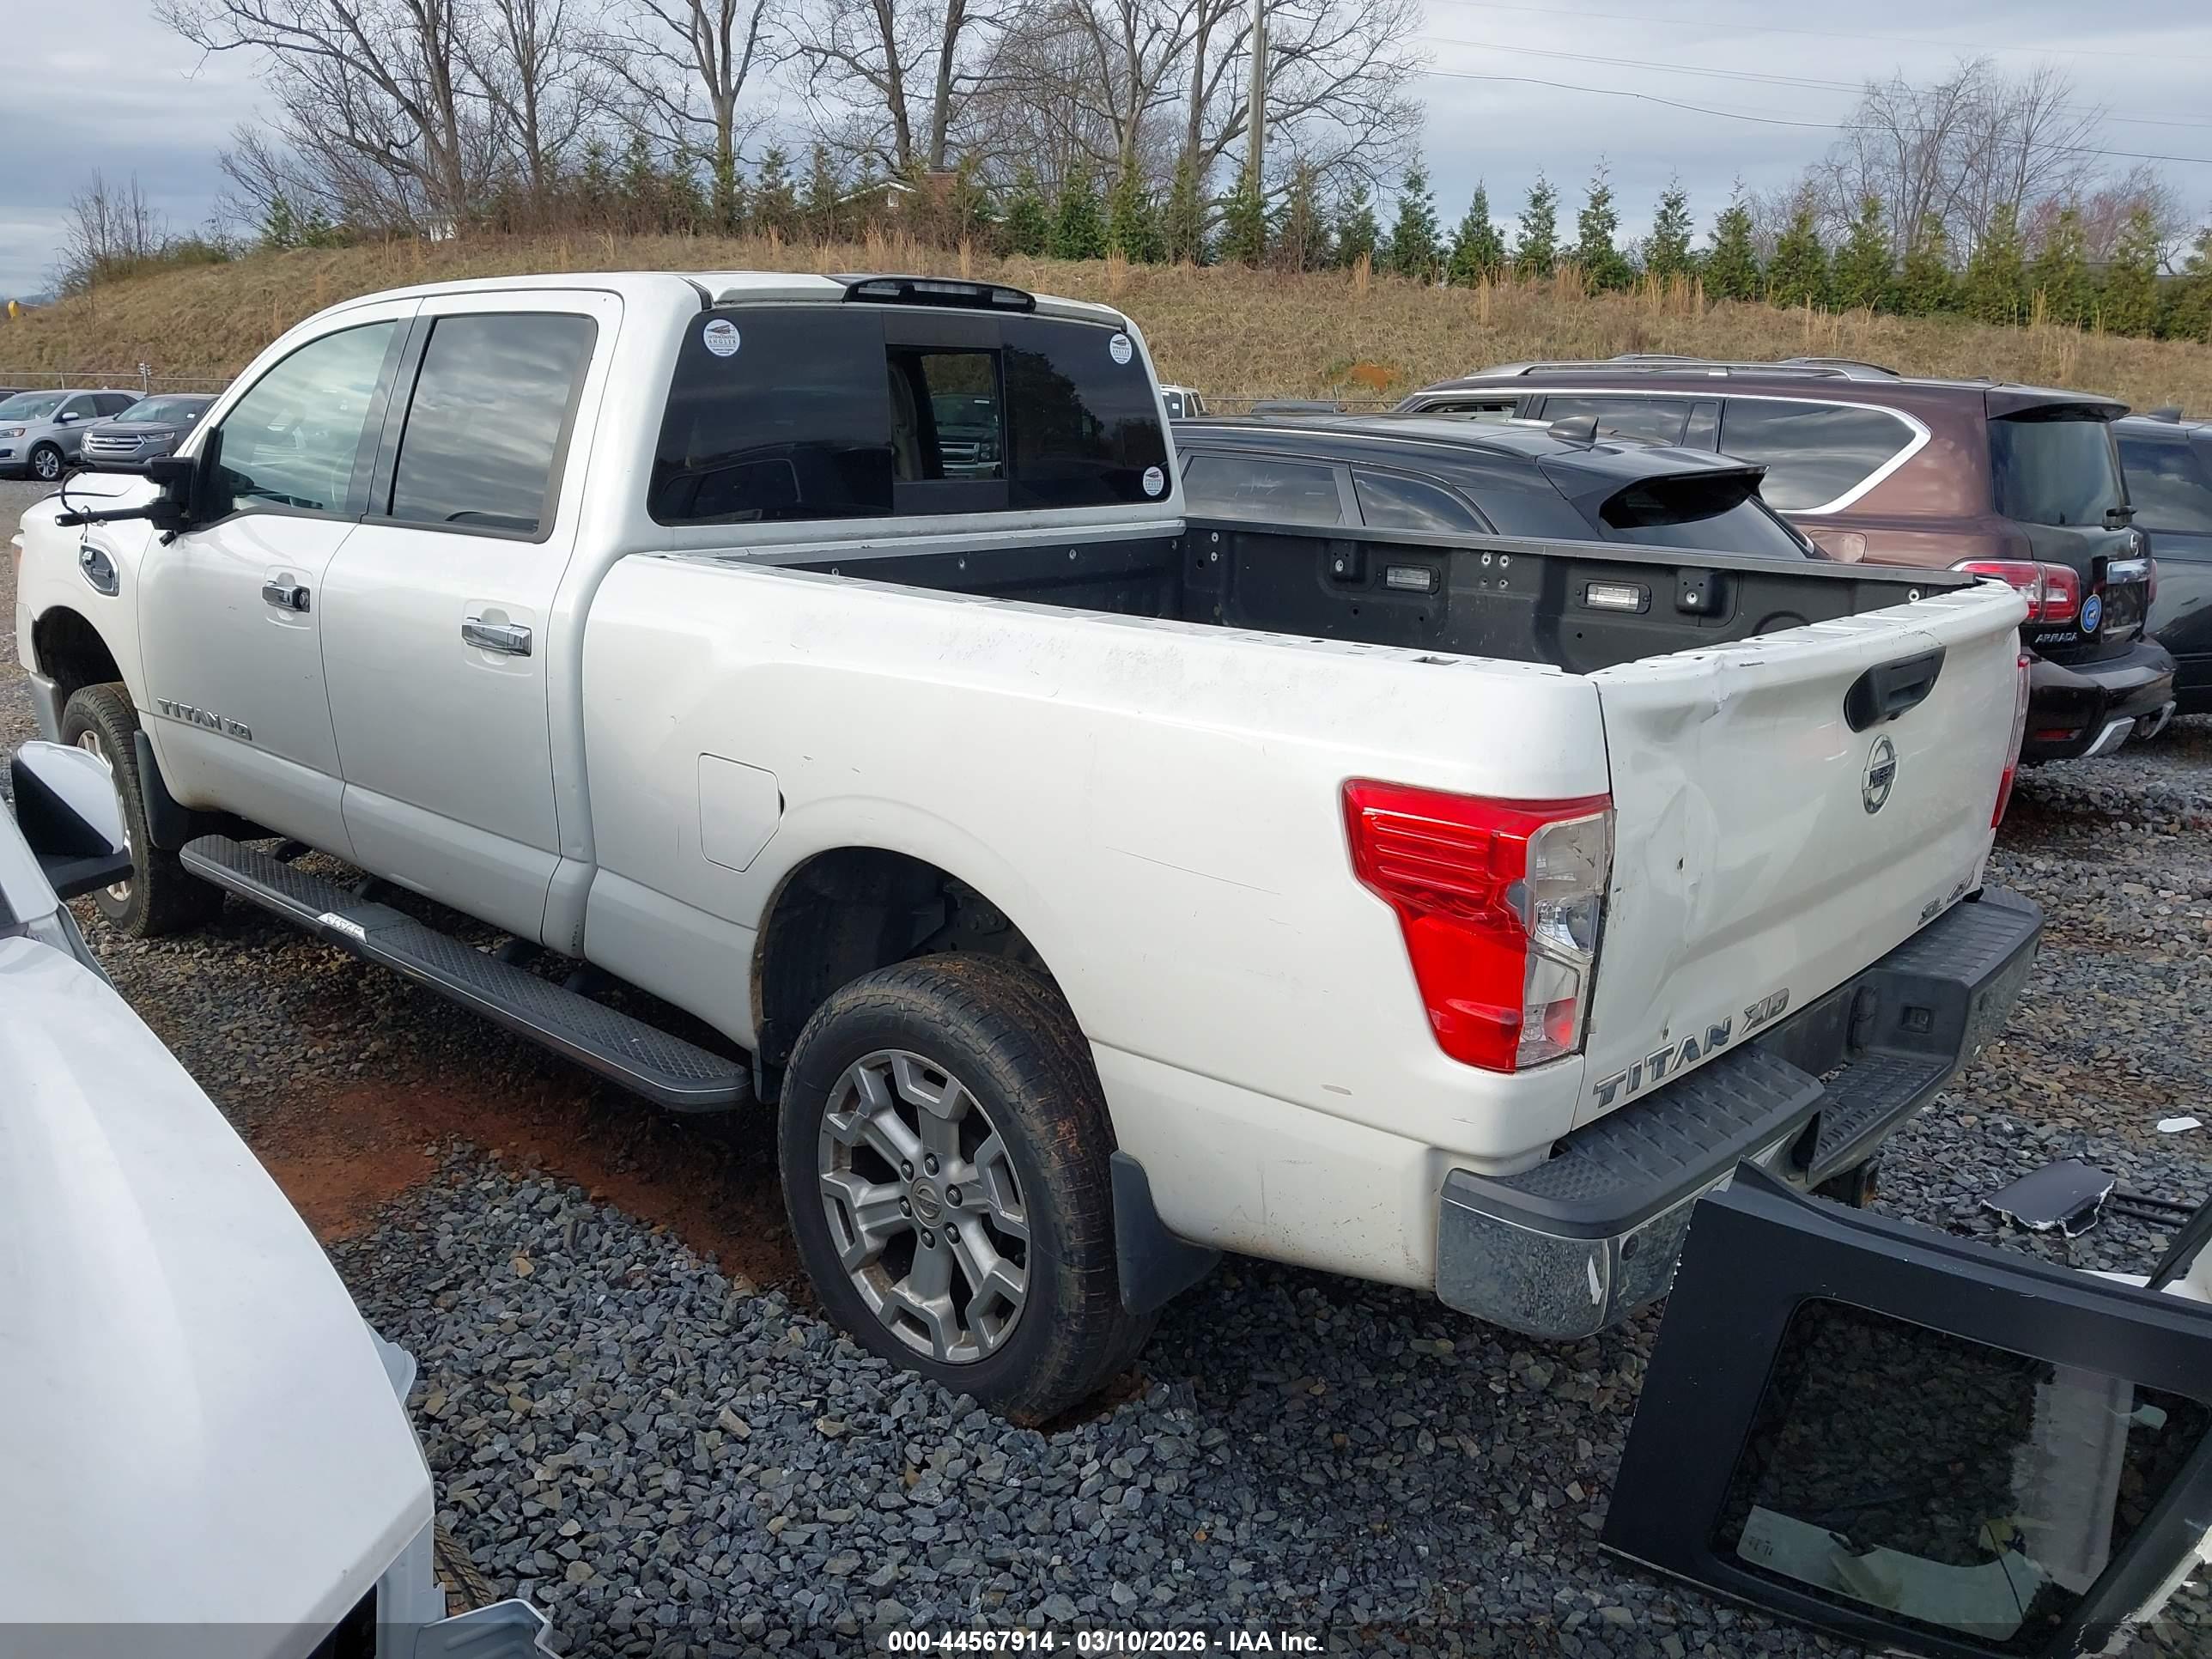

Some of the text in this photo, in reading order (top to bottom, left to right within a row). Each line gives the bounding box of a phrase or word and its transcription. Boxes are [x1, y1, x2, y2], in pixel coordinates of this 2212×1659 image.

[2035, 632, 2078, 643] ARMADA
[157, 697, 252, 741] TITAN XD
[1593, 988, 1790, 1109] TITAN XD
